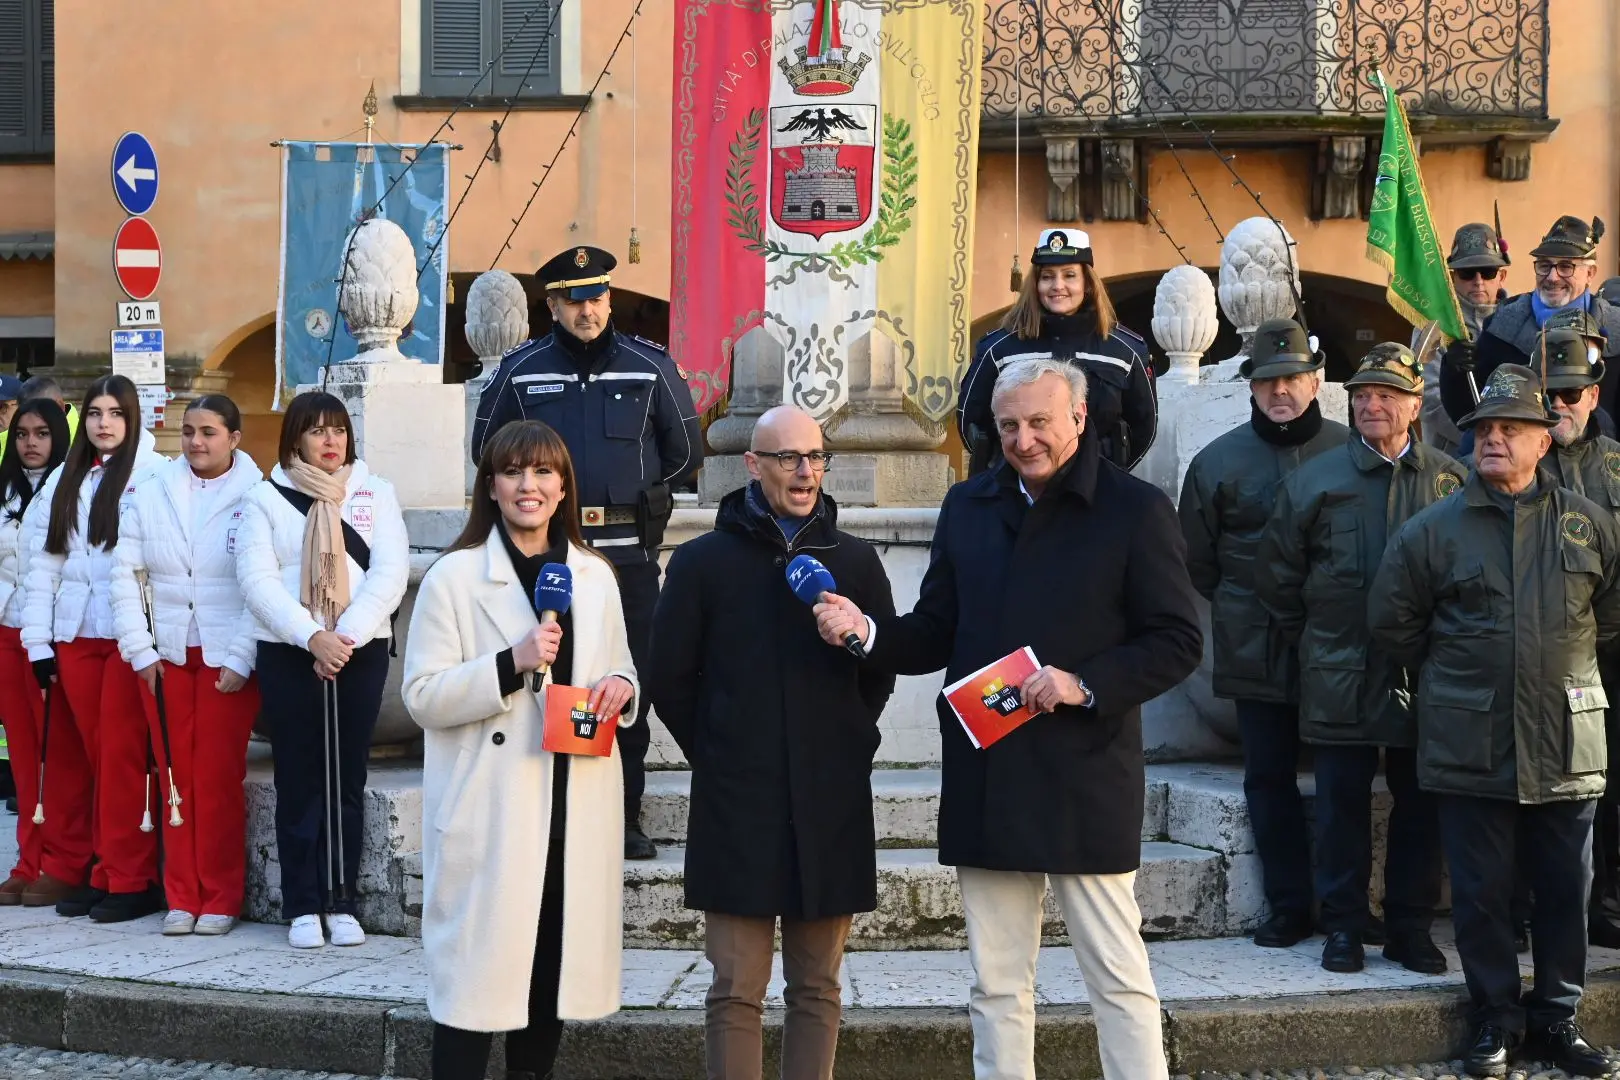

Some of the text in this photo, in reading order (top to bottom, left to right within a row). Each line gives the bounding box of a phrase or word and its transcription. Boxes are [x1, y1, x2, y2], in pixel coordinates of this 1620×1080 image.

[741, 48, 759, 68] DI
[760, 18, 868, 57] PALAZLO
[1410, 204, 1436, 267] BRESCIA
[126, 306, 155, 321] 20 m
[114, 335, 128, 344] AREA
[983, 692, 1001, 707] PIAZZA
[1001, 696, 1019, 712] NOI
[579, 723, 592, 736] NOI
